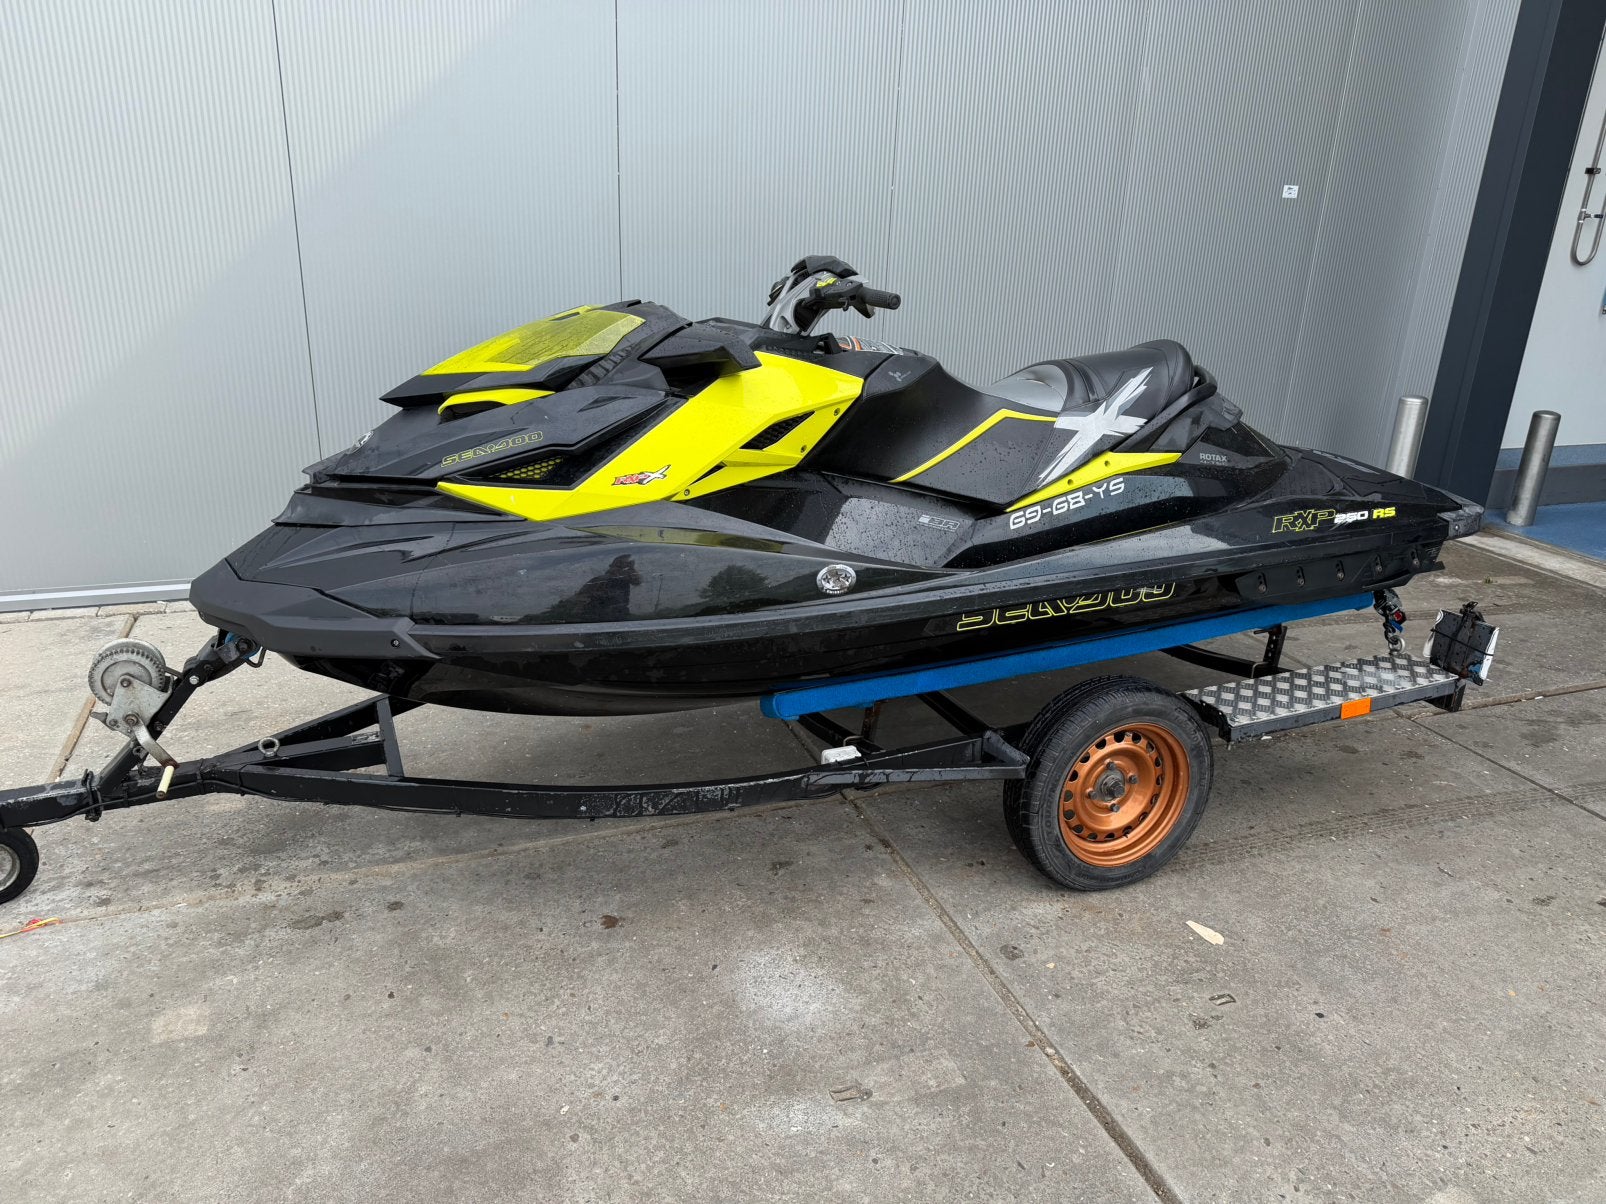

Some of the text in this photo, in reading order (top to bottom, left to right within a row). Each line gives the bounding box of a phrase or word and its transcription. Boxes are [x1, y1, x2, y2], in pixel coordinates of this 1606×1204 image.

[1199, 452, 1228, 463] ROTAX
[1271, 508, 1336, 534] RXP
[1371, 506, 1397, 520] RS
